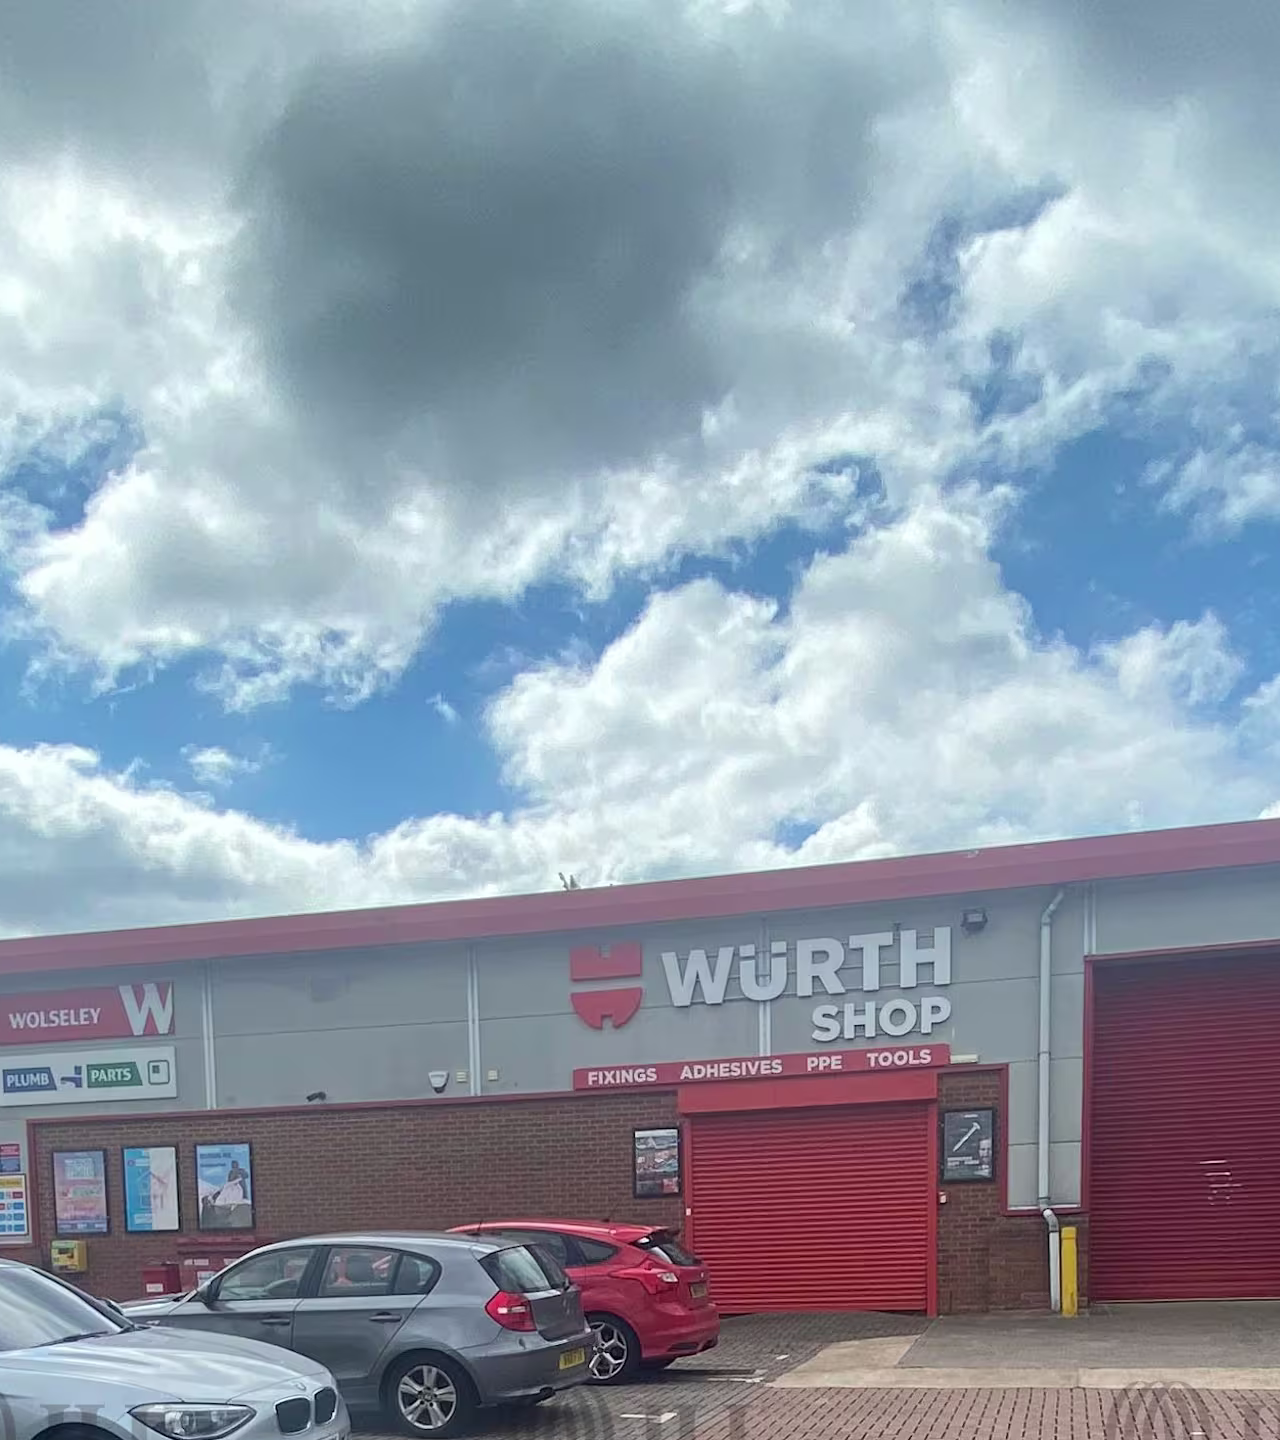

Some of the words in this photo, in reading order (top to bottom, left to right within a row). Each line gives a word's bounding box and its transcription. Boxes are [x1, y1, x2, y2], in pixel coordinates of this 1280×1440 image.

[8, 1007, 101, 1030] WOLSELEY
[119, 982, 173, 1037] W
[811, 995, 952, 1043] SHOP
[6, 1072, 50, 1088] PLUMB
[90, 1067, 132, 1082] PARTS
[587, 1067, 658, 1086] FIXINGS
[680, 1058, 784, 1080] ADHESIVES
[806, 1055, 843, 1072] PPE
[866, 1048, 932, 1068] TOOLS
